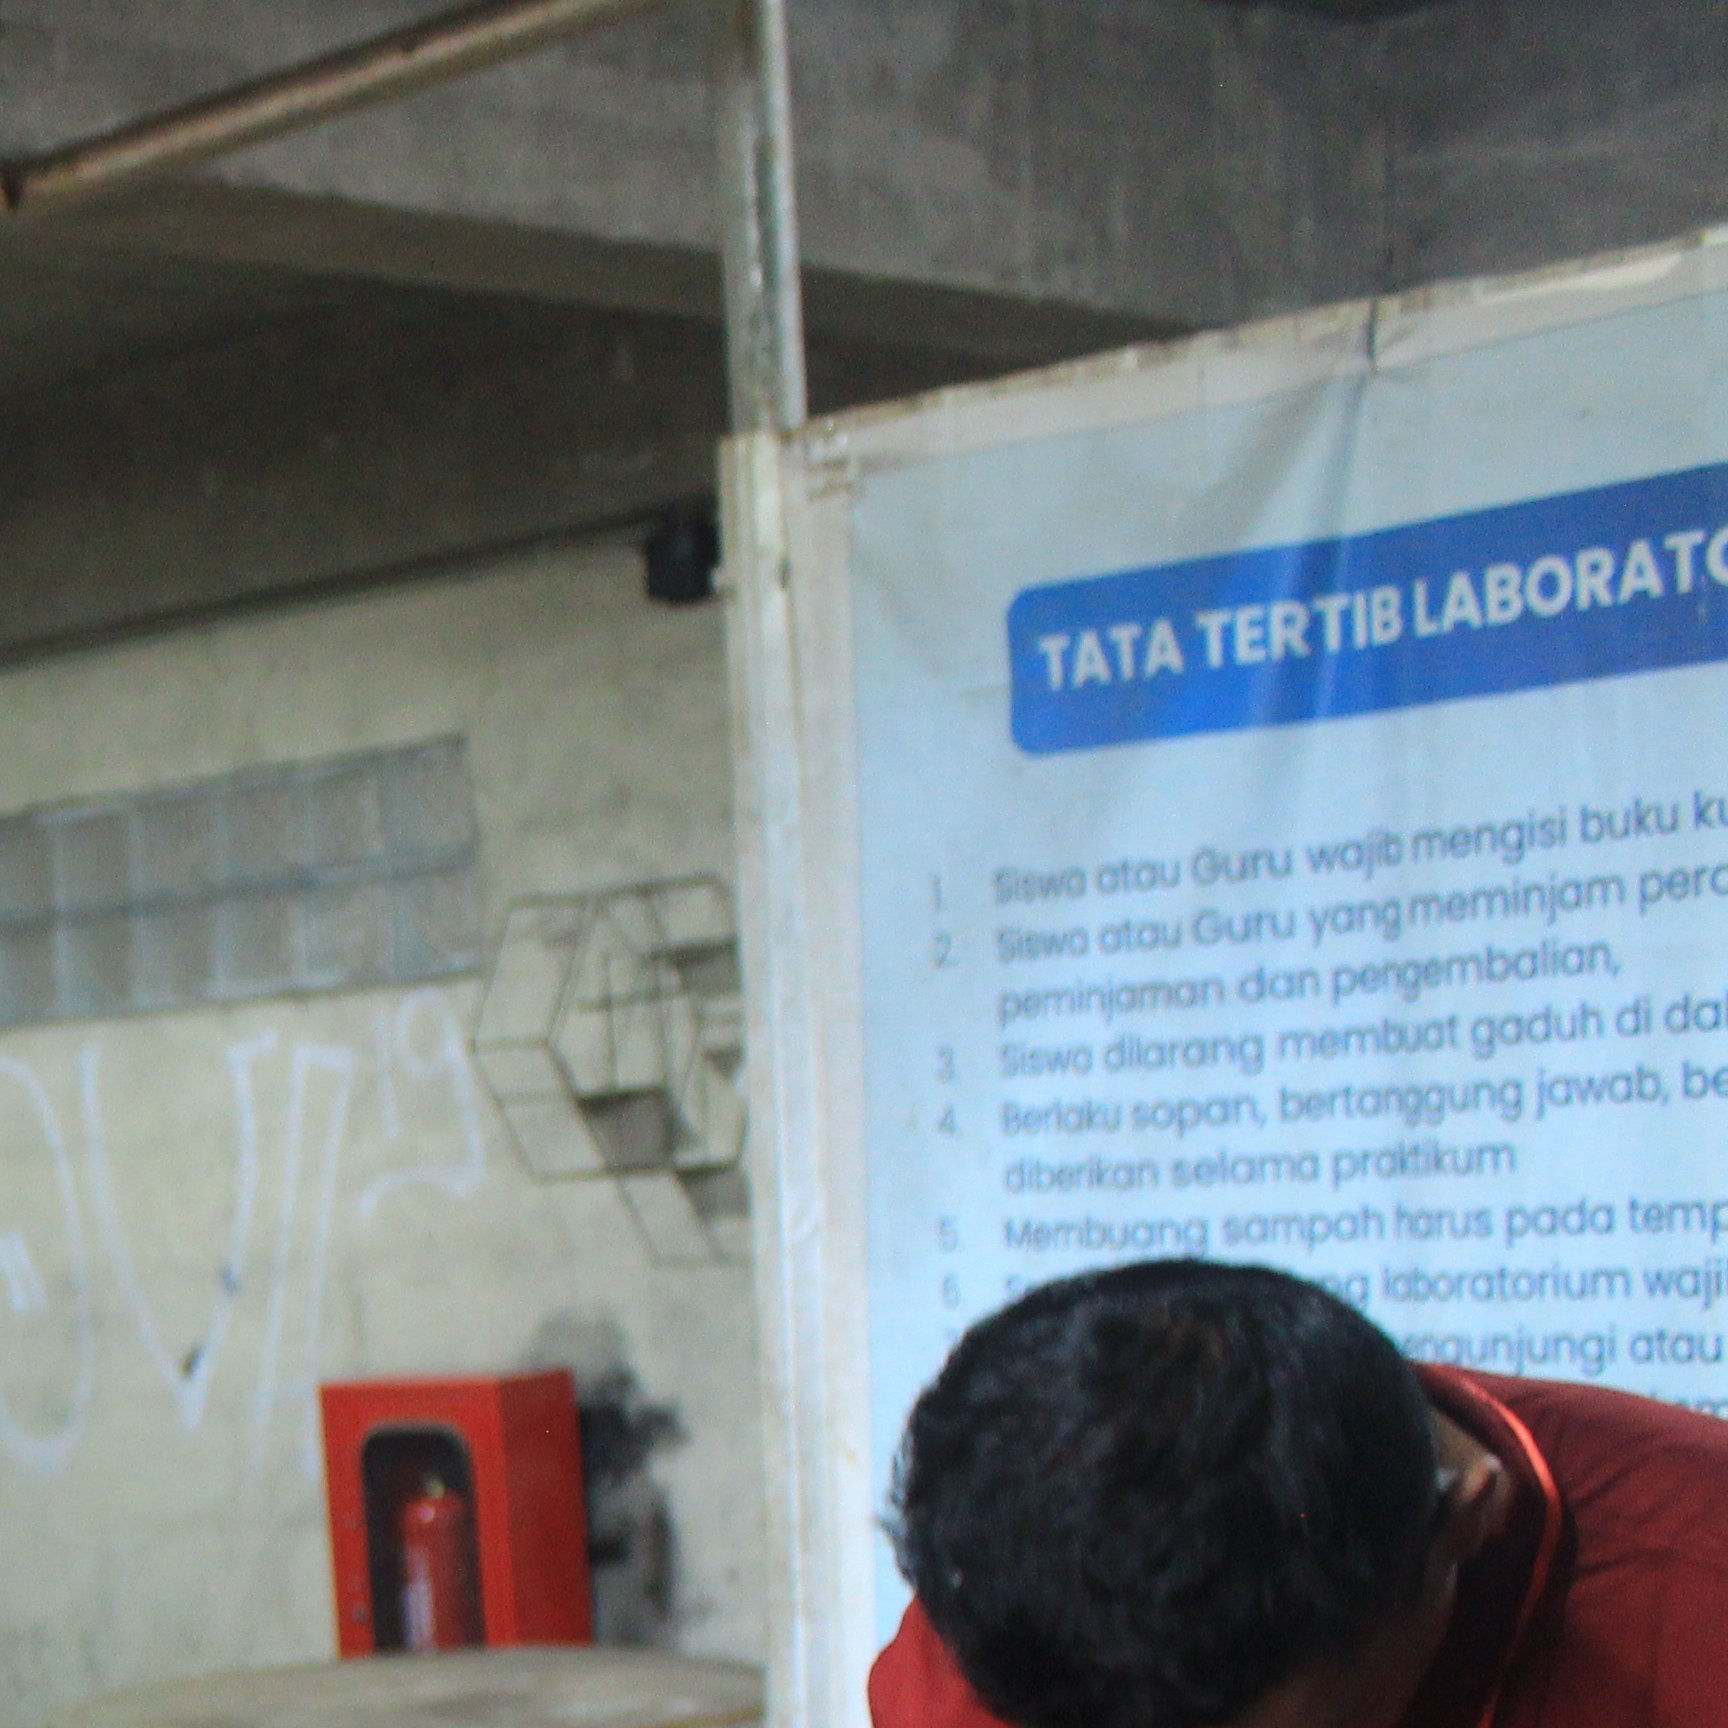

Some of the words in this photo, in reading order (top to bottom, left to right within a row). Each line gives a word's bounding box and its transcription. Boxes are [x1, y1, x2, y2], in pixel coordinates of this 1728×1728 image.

[1038, 617, 1185, 692] TATA
[1196, 585, 1404, 669] TERTIB
[993, 869, 1087, 902] Siswa
[1095, 858, 1181, 894] atau
[1192, 847, 1292, 885] Guru
[1306, 827, 1403, 880] wajib
[1411, 804, 1567, 865] mengisi
[1579, 795, 1678, 842] buku
[996, 927, 1089, 963] Siswa
[1099, 919, 1182, 953] atau
[1191, 909, 1295, 945] Guru
[1308, 903, 1401, 946] yang
[1409, 871, 1624, 925] meminjam
[998, 972, 1224, 1030] peminjaman
[1240, 967, 1319, 1001] dan
[998, 1042, 1092, 1077] Siswa
[1104, 1032, 1264, 1075] dilarang
[1279, 1015, 1459, 1059] membuat
[1471, 1002, 1601, 1060] gaduh
[1615, 995, 1652, 1037] di
[1001, 1099, 1120, 1136] Berlaku
[1279, 1076, 1523, 1126] bertanggung
[1005, 1156, 1157, 1193] diberikan
[1171, 1148, 1319, 1188] selama
[1332, 1138, 1515, 1191] praktikum
[1004, 1212, 1207, 1257] Membuang
[1221, 1204, 1383, 1252] sampah
[1394, 1200, 1493, 1239] harus
[1505, 1198, 1614, 1248] pada
[1382, 1260, 1632, 1301] laboratorium
[1644, 1254, 1728, 1310] waji
[1630, 1327, 1722, 1363] atau
